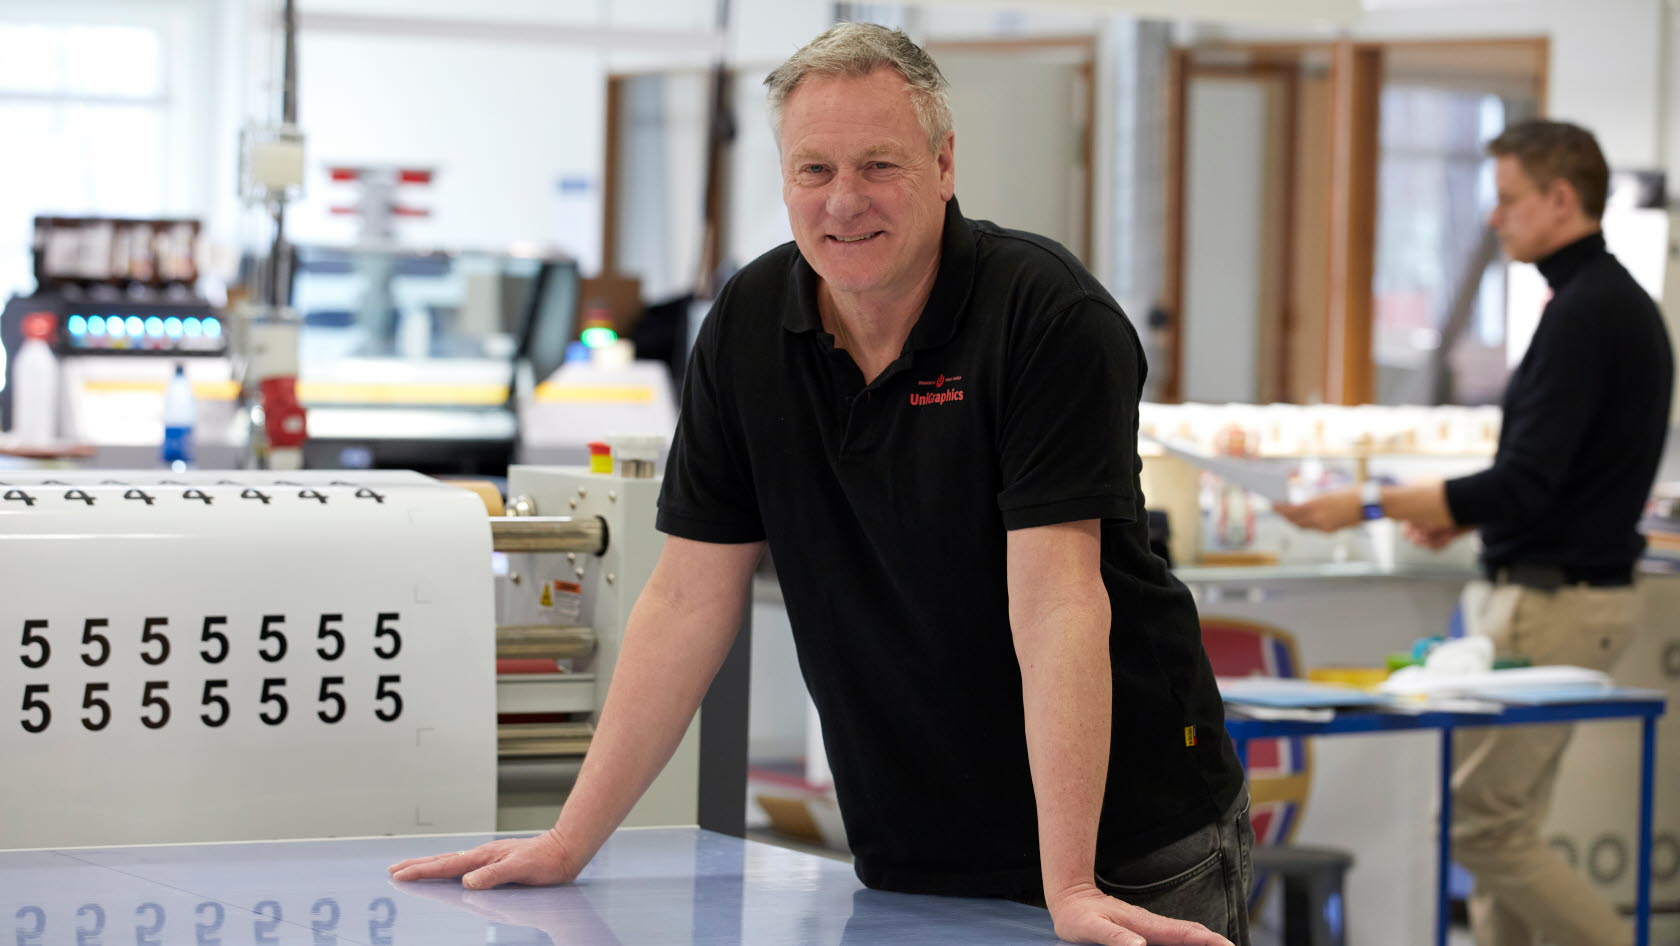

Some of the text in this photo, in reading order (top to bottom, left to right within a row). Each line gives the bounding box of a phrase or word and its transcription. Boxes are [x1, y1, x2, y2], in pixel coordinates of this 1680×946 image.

[3, 489, 386, 506] 4 4 4 4 4 4 4
[20, 612, 402, 669] 5 5 5 5 5 5 5
[20, 674, 404, 734] 5 5 5 5 5 5 5
